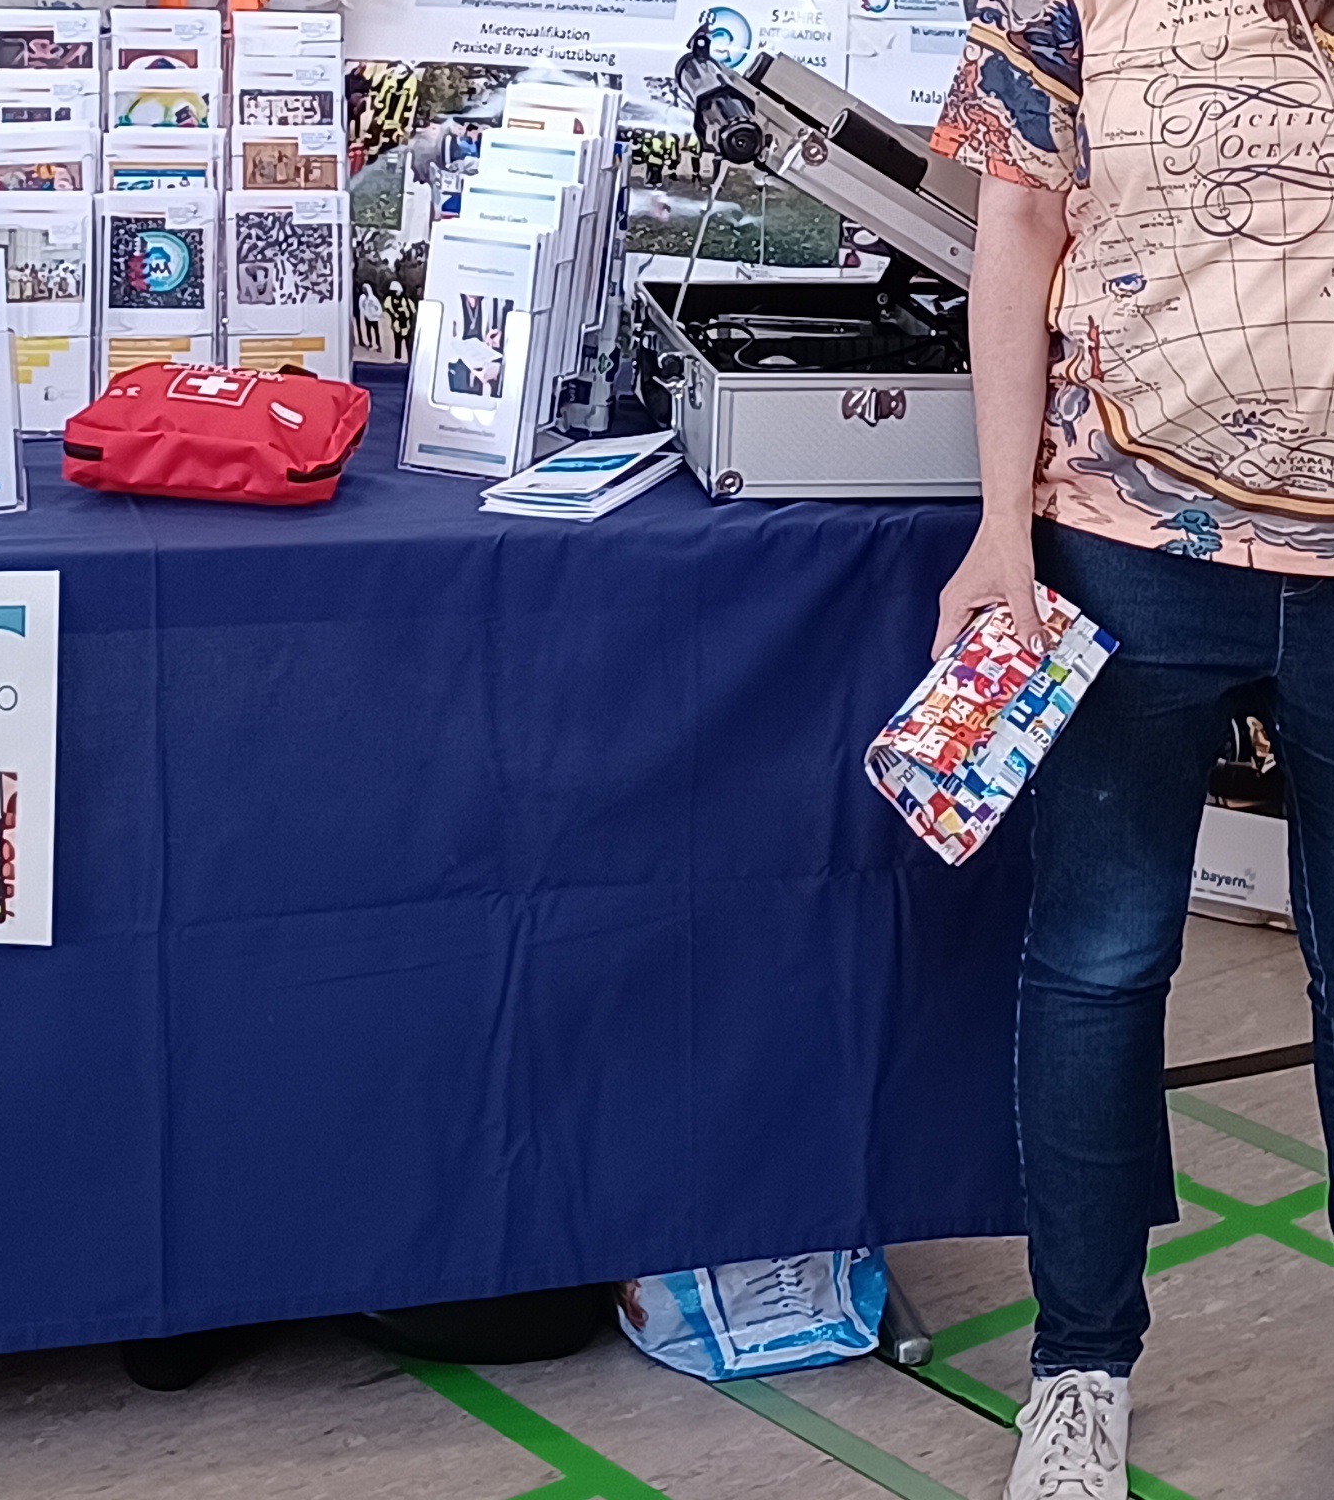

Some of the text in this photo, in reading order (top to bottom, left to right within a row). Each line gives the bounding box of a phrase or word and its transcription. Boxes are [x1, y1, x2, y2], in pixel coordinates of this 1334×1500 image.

[771, 9, 780, 23] 5
[480, 23, 590, 42] Mieterqualifikation
[452, 41, 501, 56] Praxisteil
[1219, 134, 1321, 160] OCEAN
[1200, 867, 1247, 889] bayern
